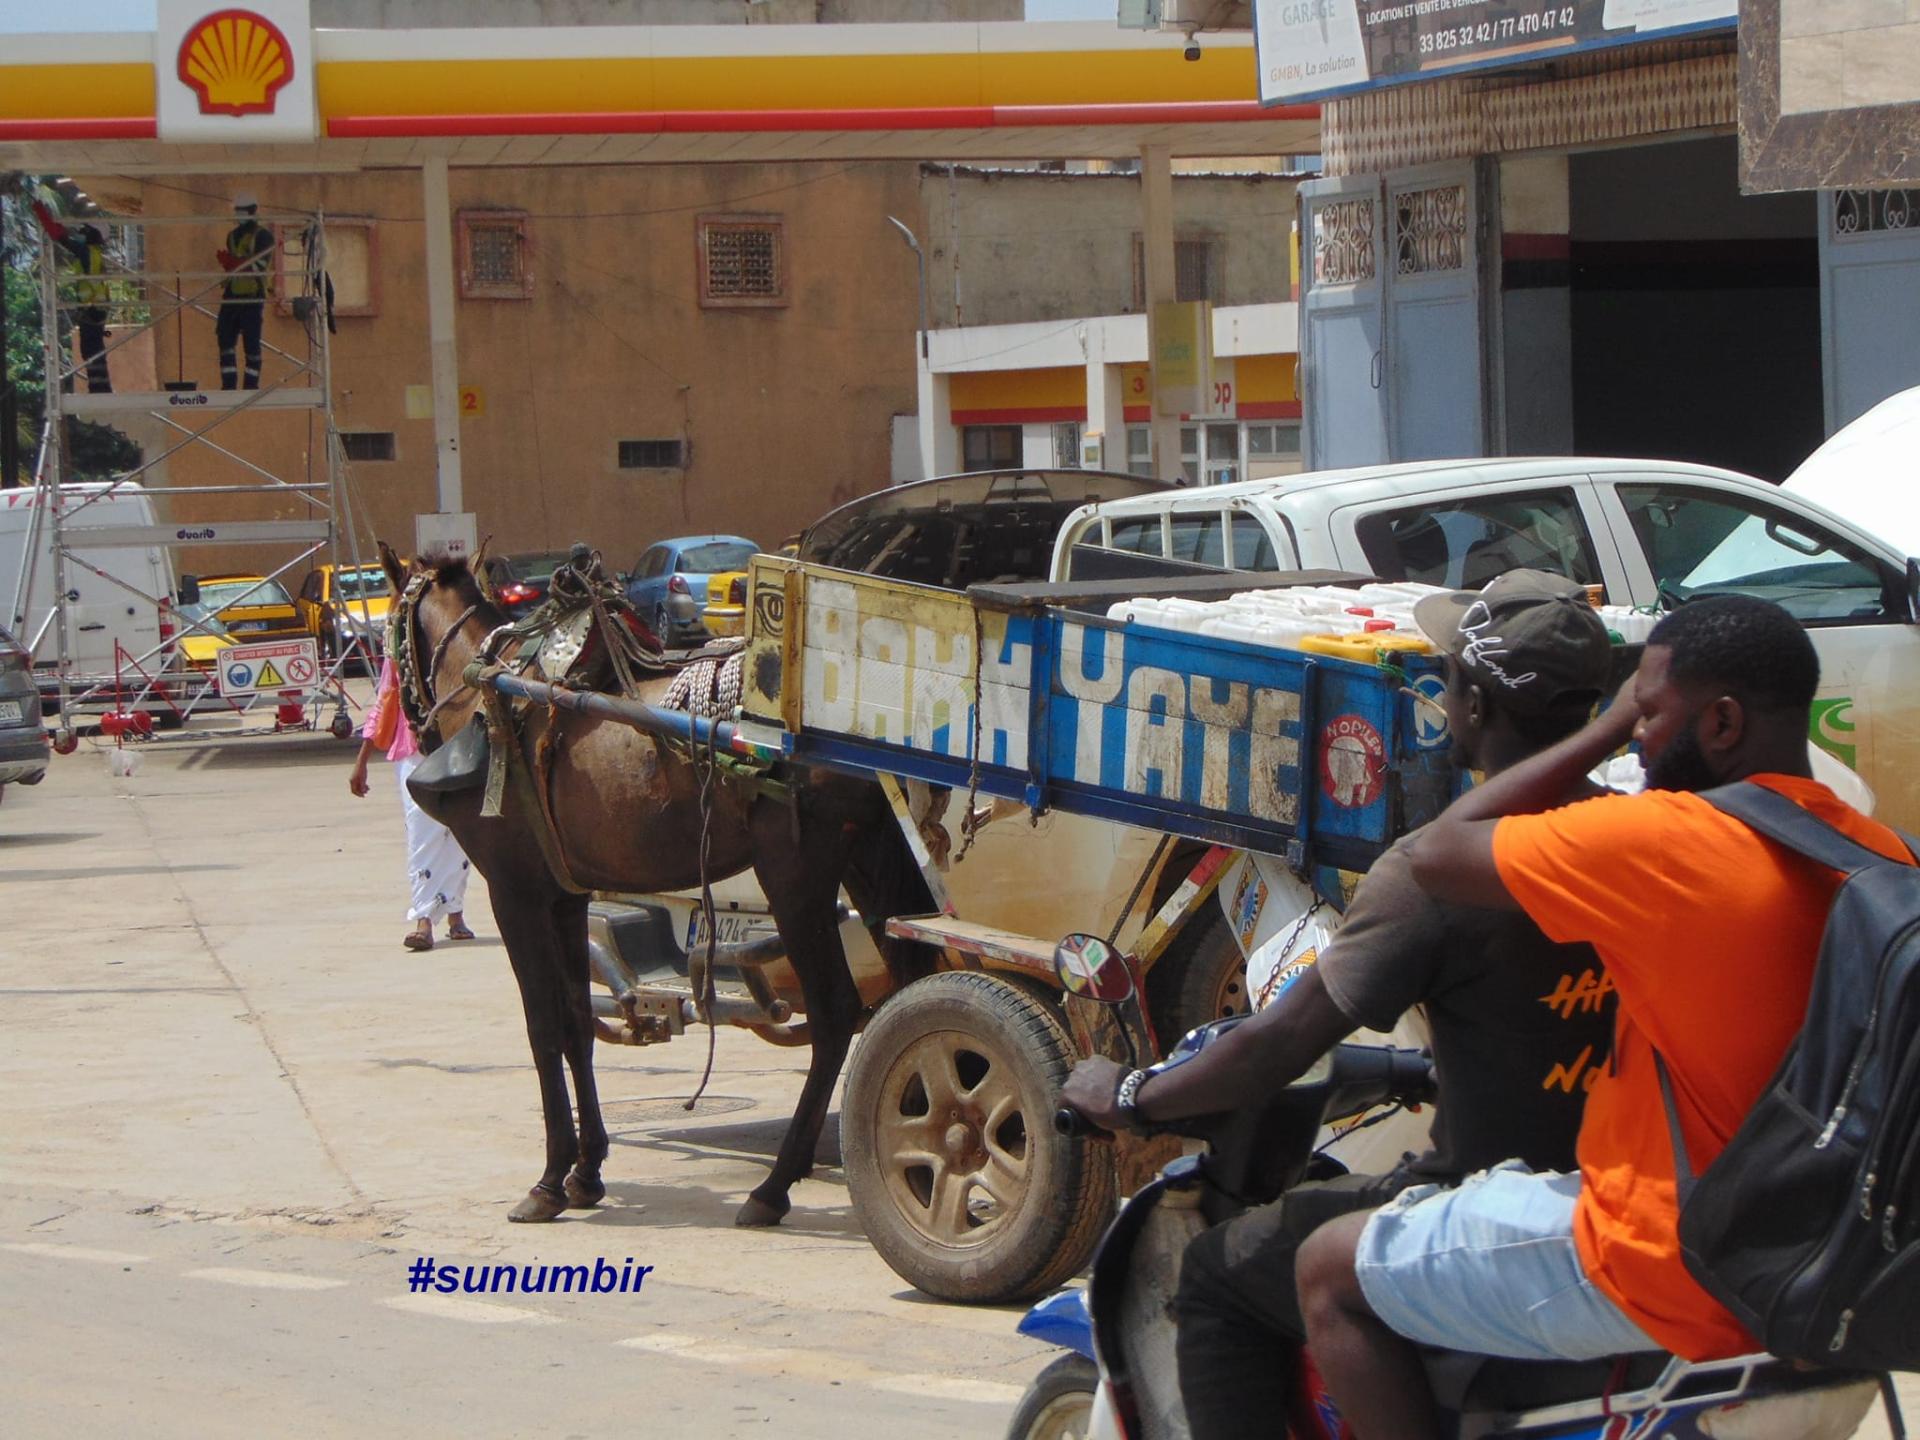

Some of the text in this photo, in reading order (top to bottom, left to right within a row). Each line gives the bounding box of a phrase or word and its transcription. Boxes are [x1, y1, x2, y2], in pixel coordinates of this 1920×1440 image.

[1366, 8, 1403, 25] LOCATION
[1404, 5, 1416, 17] ET
[1415, 1, 1440, 15] VENTE
[1440, 0, 1451, 10] DE
[1420, 7, 1574, 53] 33 825 32 42 / 77 470 47 42
[1319, 55, 1355, 74] solution
[1133, 377, 1144, 393] 3
[464, 393, 477, 409] 2
[1060, 621, 1302, 826] YAYE
